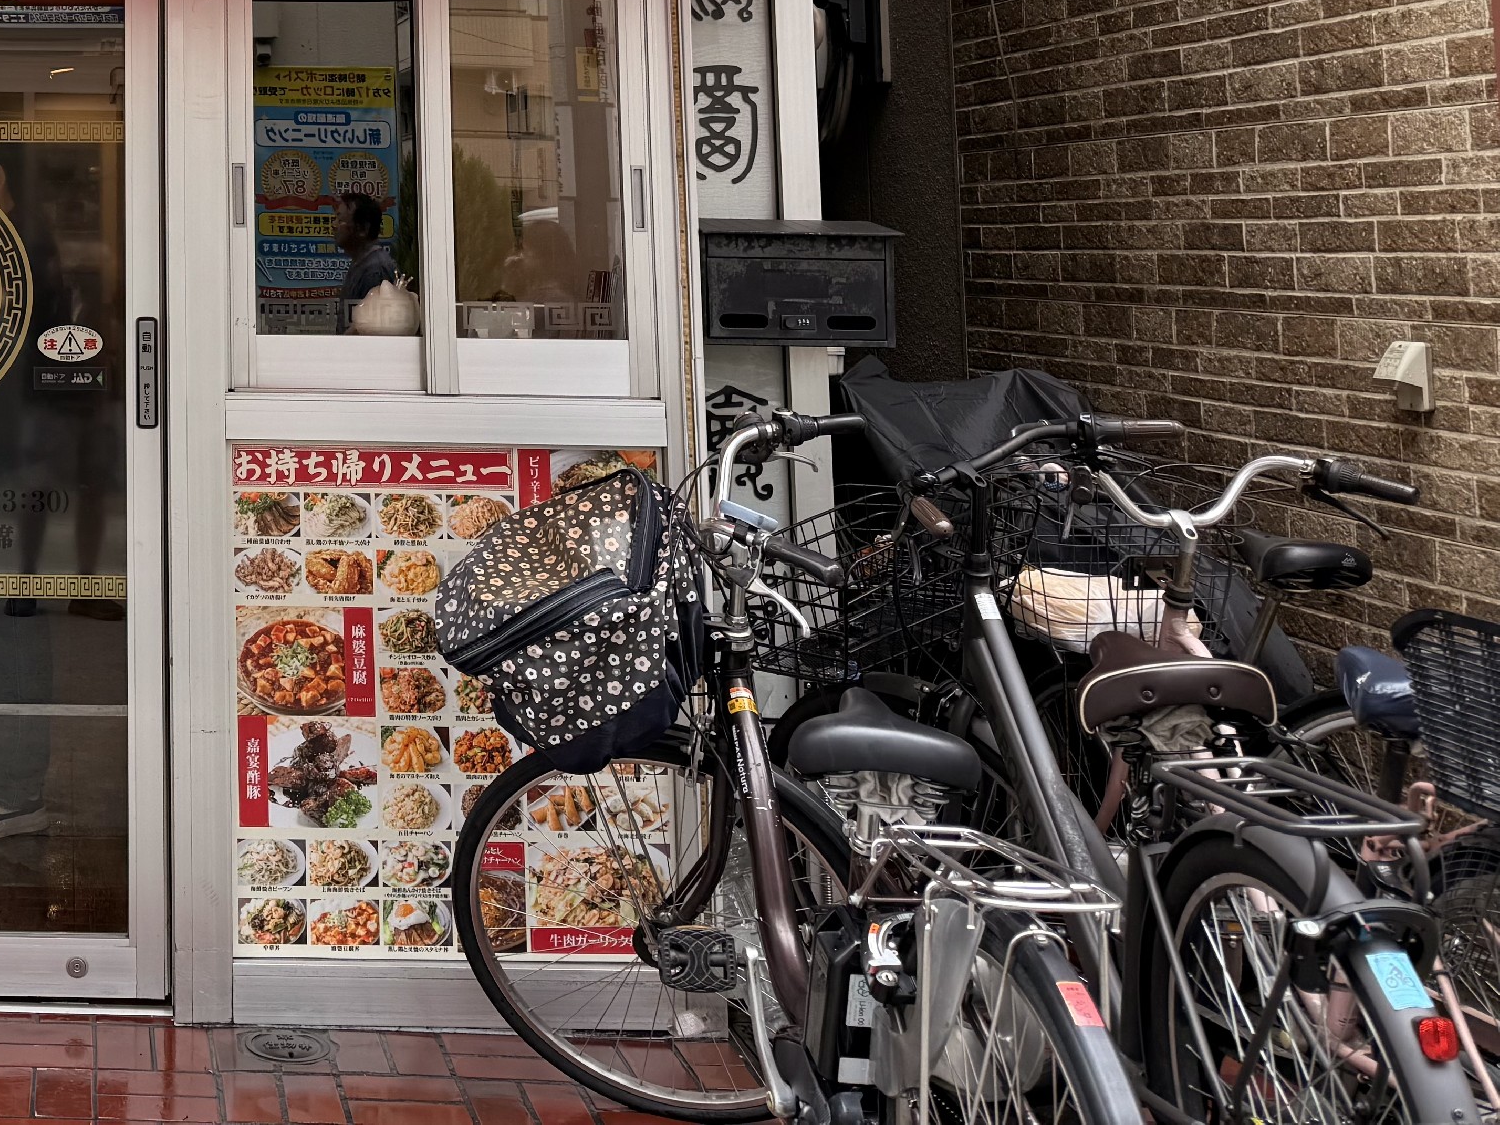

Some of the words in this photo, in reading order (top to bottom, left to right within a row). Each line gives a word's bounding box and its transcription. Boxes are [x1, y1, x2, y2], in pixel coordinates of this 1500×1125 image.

[141, 331, 152, 354] 自動
[233, 448, 514, 487] お持ち帰りメニュー
[351, 624, 367, 685] 麻婆豆腐
[246, 737, 261, 800] 嘉宴酢豚
[736, 758, 749, 794] Natura
